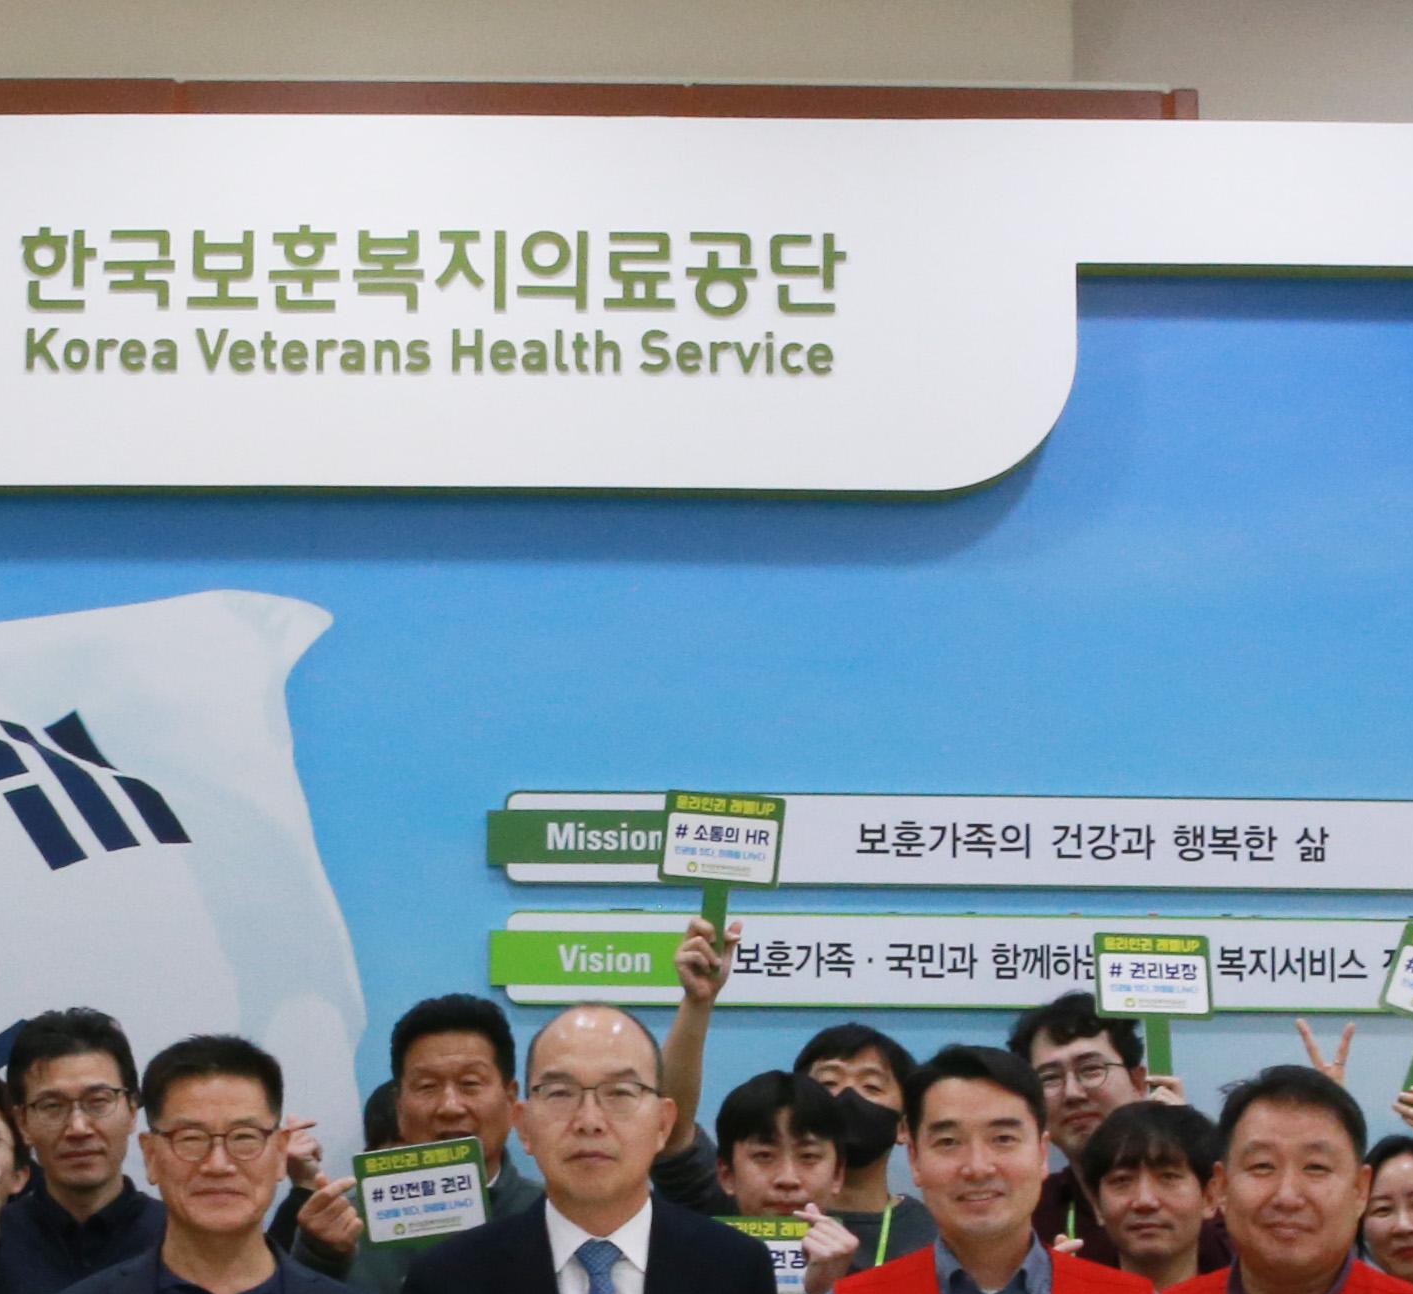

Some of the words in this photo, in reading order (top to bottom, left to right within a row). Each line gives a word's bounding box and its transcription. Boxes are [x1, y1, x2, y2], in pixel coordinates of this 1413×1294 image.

[20, 222, 847, 316] 한국보훈복지의료공단
[23, 327, 177, 373] Korea
[195, 328, 431, 373] Veterans
[451, 328, 621, 374] Health
[640, 330, 834, 375] Service
[546, 822, 662, 851] Mission
[675, 824, 689, 839] #
[746, 829, 769, 845] HR
[856, 821, 1030, 859] 보훈가족의
[1052, 823, 1155, 860] 건강과
[1173, 824, 1278, 862] 행복한
[1296, 826, 1329, 862] 삶
[559, 944, 651, 973] Vision
[733, 940, 855, 978] 보훈가족
[886, 943, 977, 979] 국민과
[1109, 963, 1123, 977] #
[1129, 962, 1198, 980] 권리보장
[1217, 946, 1367, 982] 복지서비스
[372, 1187, 384, 1202] #
[441, 1174, 472, 1194] 권리
